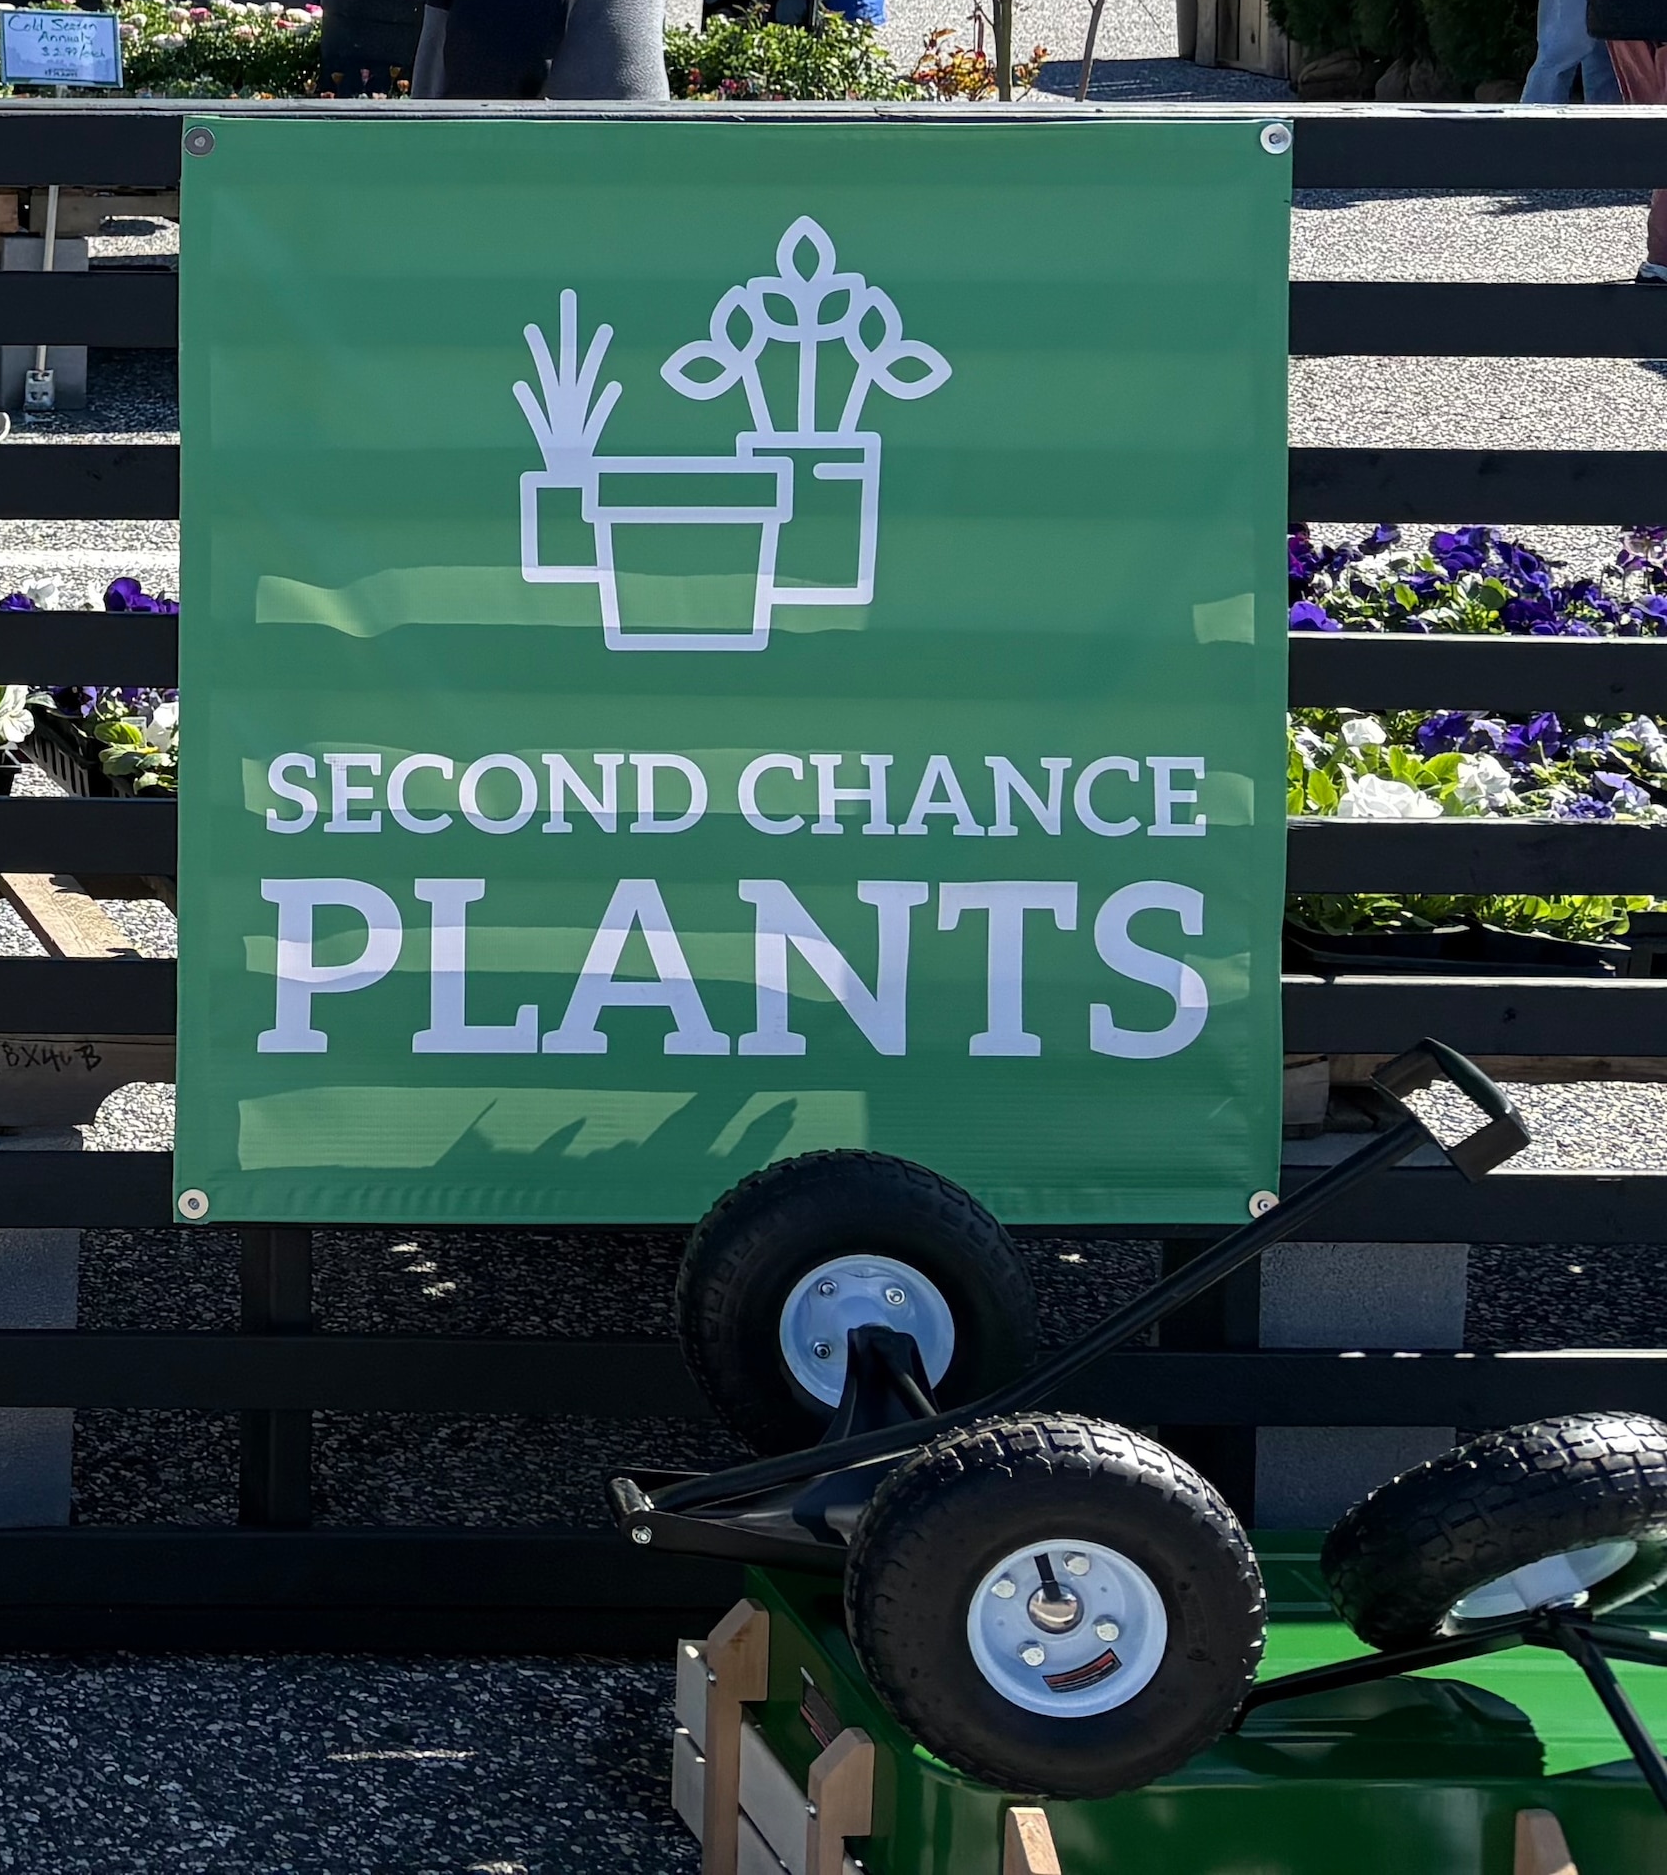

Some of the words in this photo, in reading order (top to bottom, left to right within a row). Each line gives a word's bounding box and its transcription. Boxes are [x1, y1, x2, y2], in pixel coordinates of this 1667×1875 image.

[8, 15, 43, 32] Cold
[51, 18, 98, 32] Season
[266, 753, 709, 835] SECOND
[738, 753, 1207, 837] CHANCE
[257, 878, 1209, 1059] PLANTS
